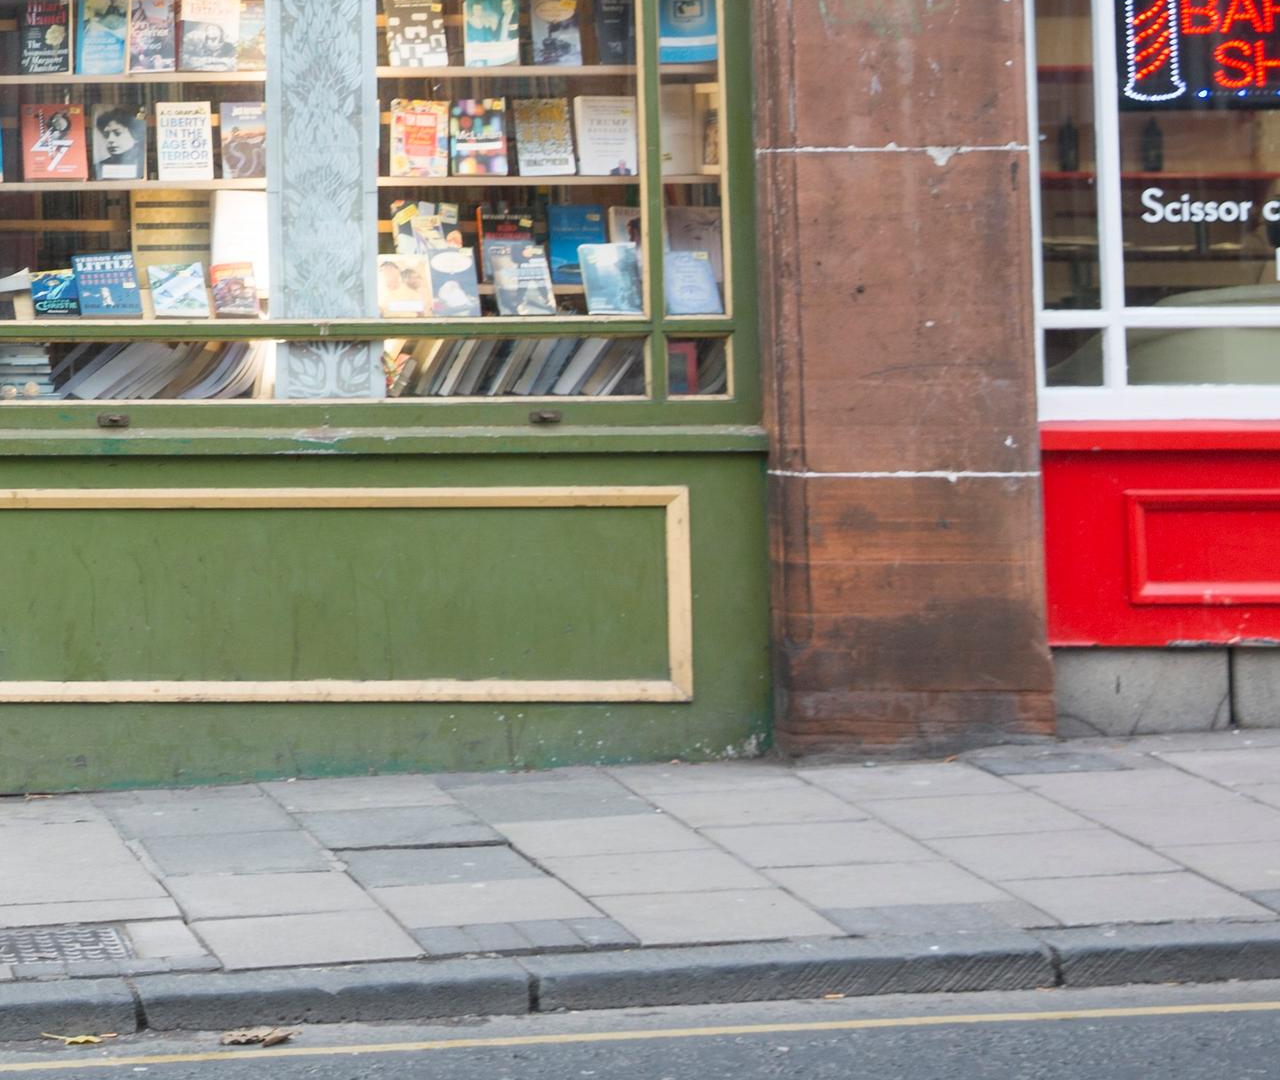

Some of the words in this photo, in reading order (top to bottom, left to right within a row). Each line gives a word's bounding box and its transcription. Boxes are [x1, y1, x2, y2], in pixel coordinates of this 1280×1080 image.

[160, 116, 207, 127] LIBERTY
[160, 151, 209, 161] TERROR
[1141, 187, 1253, 223] Scissor
